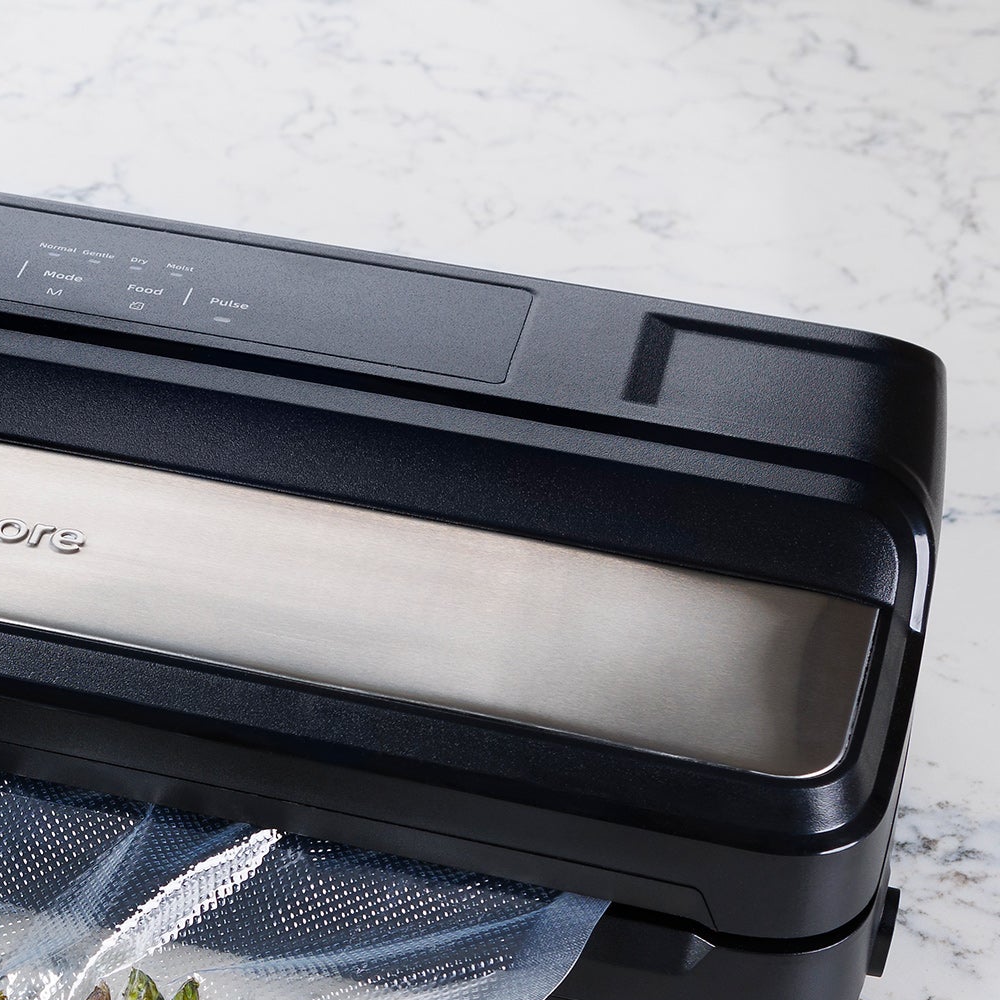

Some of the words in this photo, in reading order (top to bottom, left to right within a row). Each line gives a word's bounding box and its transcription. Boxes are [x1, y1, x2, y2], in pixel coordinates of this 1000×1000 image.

[39, 242, 77, 253] Normal
[82, 249, 115, 259] Gentle
[130, 257, 149, 265] Dry
[166, 262, 194, 273] Moist
[43, 270, 83, 283] Mode
[127, 283, 164, 296] Food
[210, 297, 249, 310] Pulse
